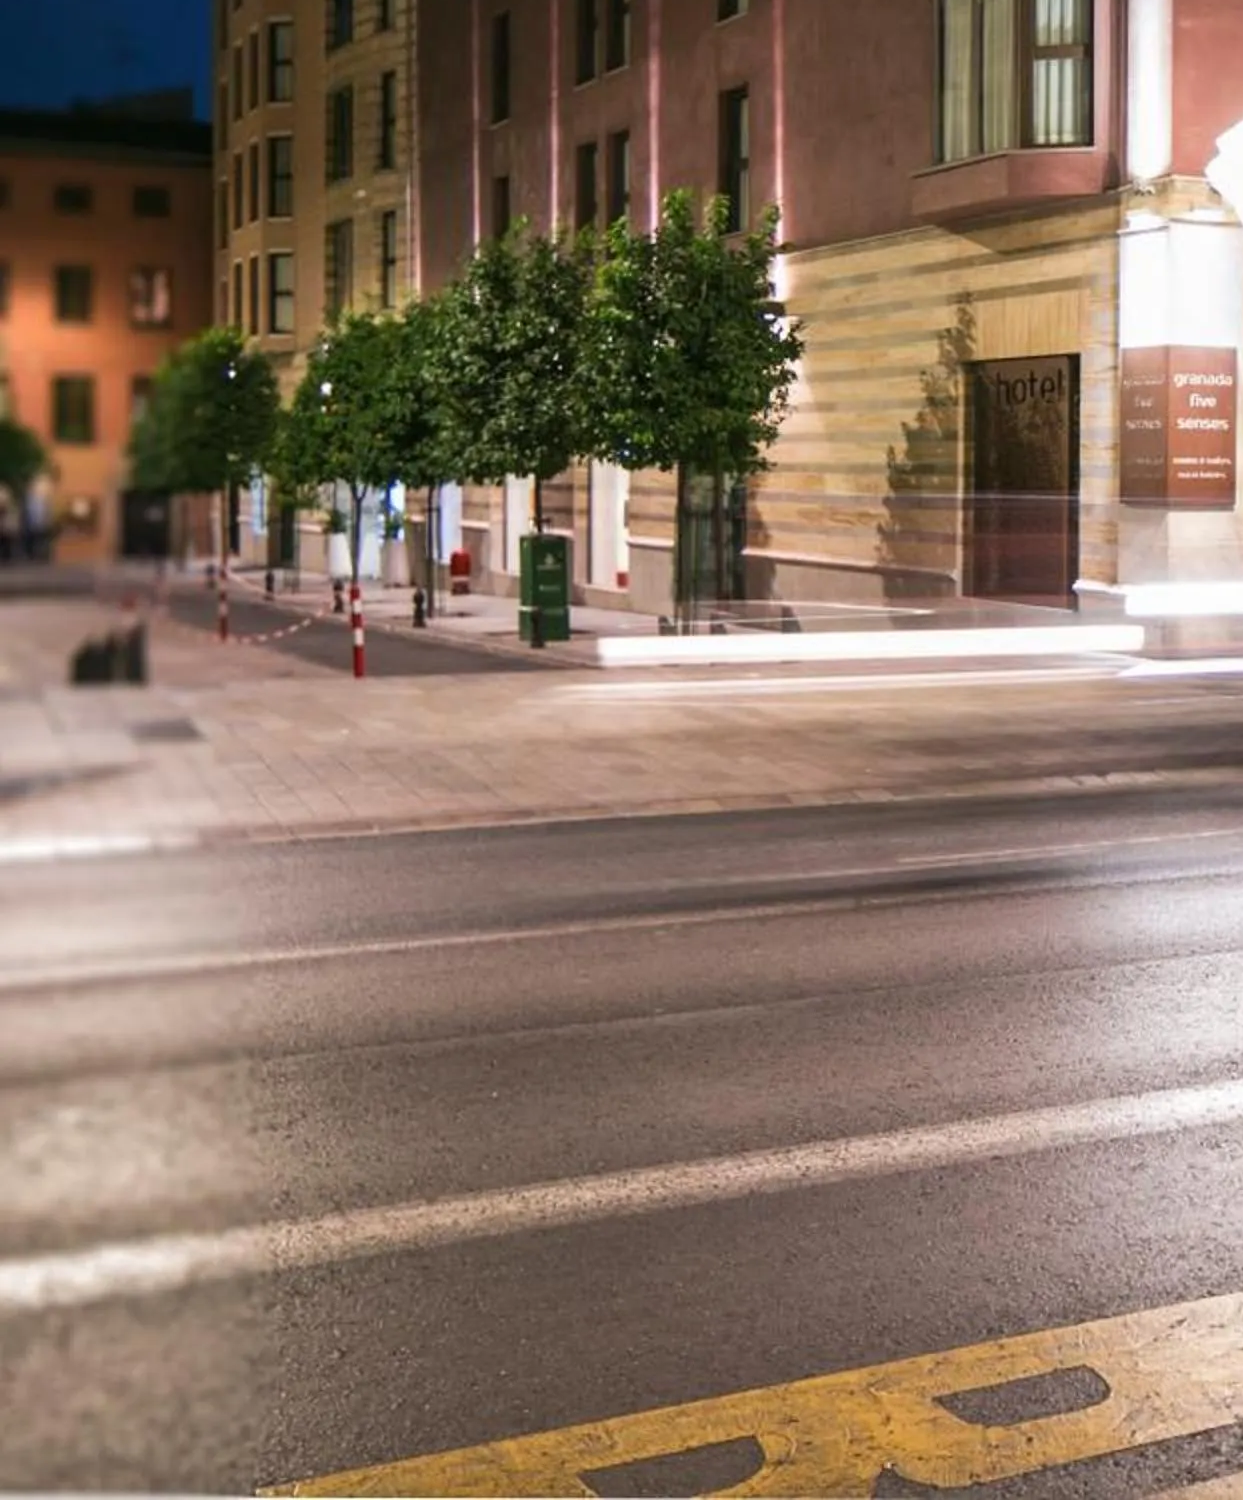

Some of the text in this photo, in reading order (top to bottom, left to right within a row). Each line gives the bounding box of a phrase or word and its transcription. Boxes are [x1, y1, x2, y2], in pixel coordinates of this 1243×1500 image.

[995, 367, 1063, 406] hotel
[1173, 372, 1233, 388] granada
[1189, 393, 1217, 408] five
[1176, 417, 1229, 431] senses
